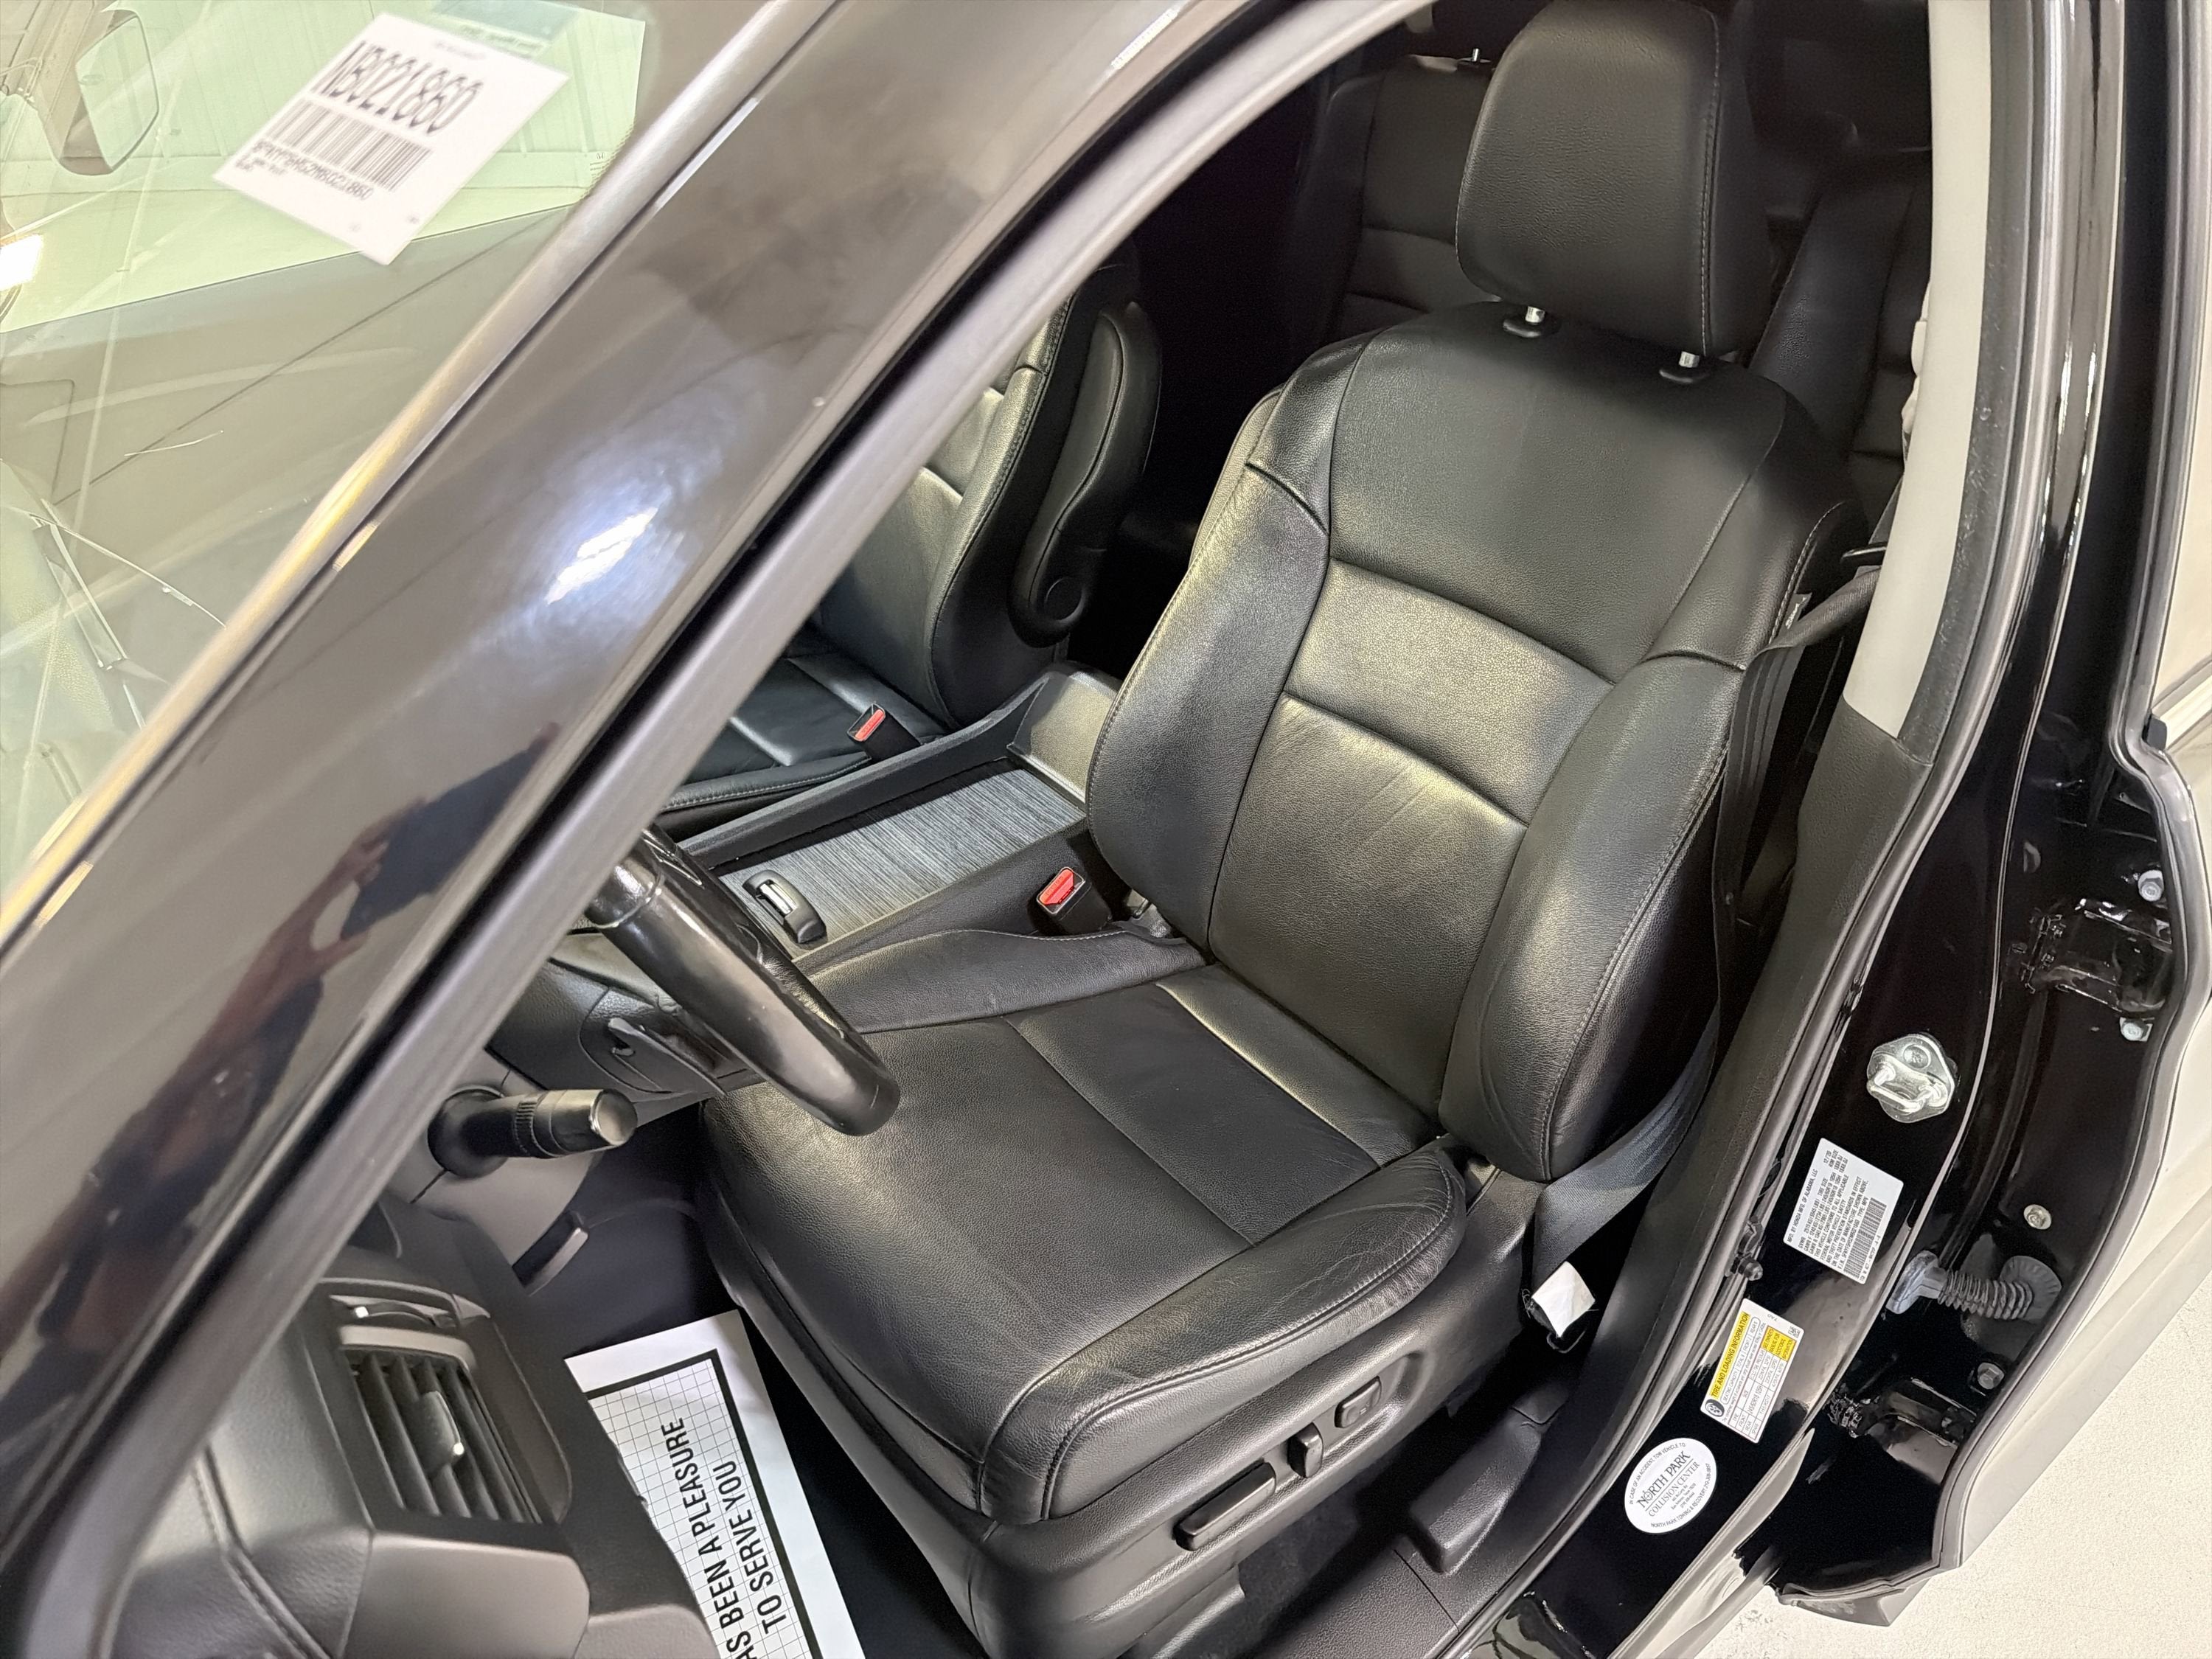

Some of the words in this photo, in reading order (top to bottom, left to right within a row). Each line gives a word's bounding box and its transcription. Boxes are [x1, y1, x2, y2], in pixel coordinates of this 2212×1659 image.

[1793, 1213, 1801, 1226] HONDA
[1818, 1232, 1827, 1248] VEHICLE
[1824, 1211, 1834, 1232] CONFORMS
[1837, 1175, 1848, 1197] APPLICABLE
[1820, 1245, 1829, 1260] FEDERAL
[1826, 1230, 1834, 1244] MOTOR
[1832, 1214, 1840, 1230] VEHICLE
[1837, 1199, 1846, 1214] SAFETY
[1834, 1220, 1845, 1242] PREVENTION
[1843, 1197, 1854, 1219] STANDARDS
[1853, 1176, 1861, 1192] EFFECT
[1843, 1208, 1857, 1237] MANUFACTURE
[1854, 1194, 1863, 1208] SHOWN
[1711, 1384, 1721, 1397] TIRE
[1717, 1372, 1725, 1385] AND
[1722, 1349, 1735, 1373] LOADING
[1731, 1312, 1749, 1349] INFORMATION
[661, 1417, 715, 1537] PLEASURE
[712, 1461, 745, 1512] YOU
[1636, 1474, 1669, 1509] NORTH
[1664, 1450, 1691, 1477] PARK
[1649, 1484, 1679, 1517] COLLISION
[1677, 1461, 1700, 1486] CENTER
[698, 1535, 723, 1557] A
[728, 1509, 773, 1592] SERVE
[703, 1559, 744, 1629] BEEN
[757, 1595, 787, 1634] TO
